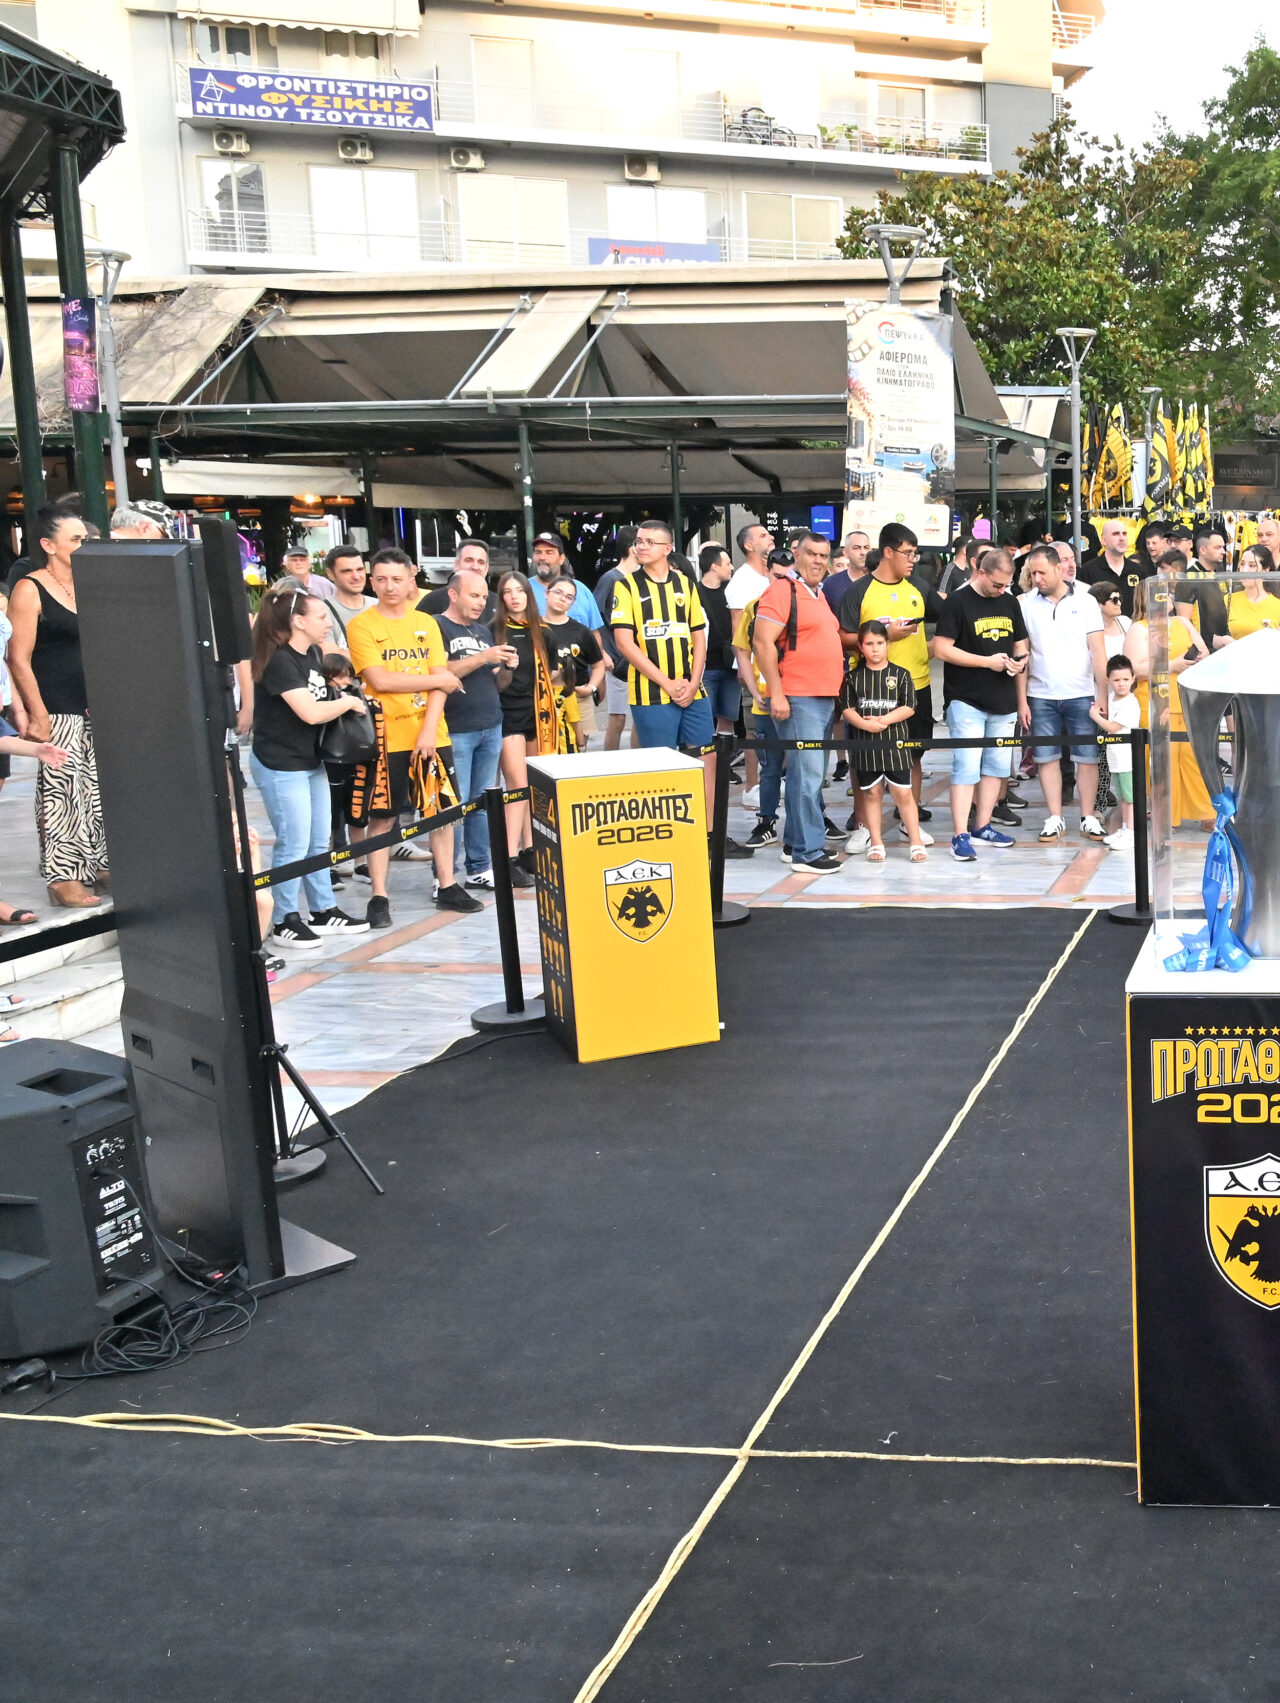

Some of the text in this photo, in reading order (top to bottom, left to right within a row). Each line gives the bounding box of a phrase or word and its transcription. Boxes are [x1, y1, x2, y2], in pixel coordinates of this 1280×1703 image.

[236, 73, 429, 101] ΦΡΟΝΤΙΣΤΗΡΙΟ
[196, 101, 430, 129] ΝΤΙΝΟΥ ΤΣΟΥΤΣΙΚΑ
[260, 91, 415, 114] ΦΥΣΙΚΗΣ
[879, 350, 928, 366] ΑΦΙΕΡΩΜΑ
[571, 793, 695, 836] ΠΡΩΤΑΘΛΗΤΕΣ
[597, 823, 674, 846] 2026
